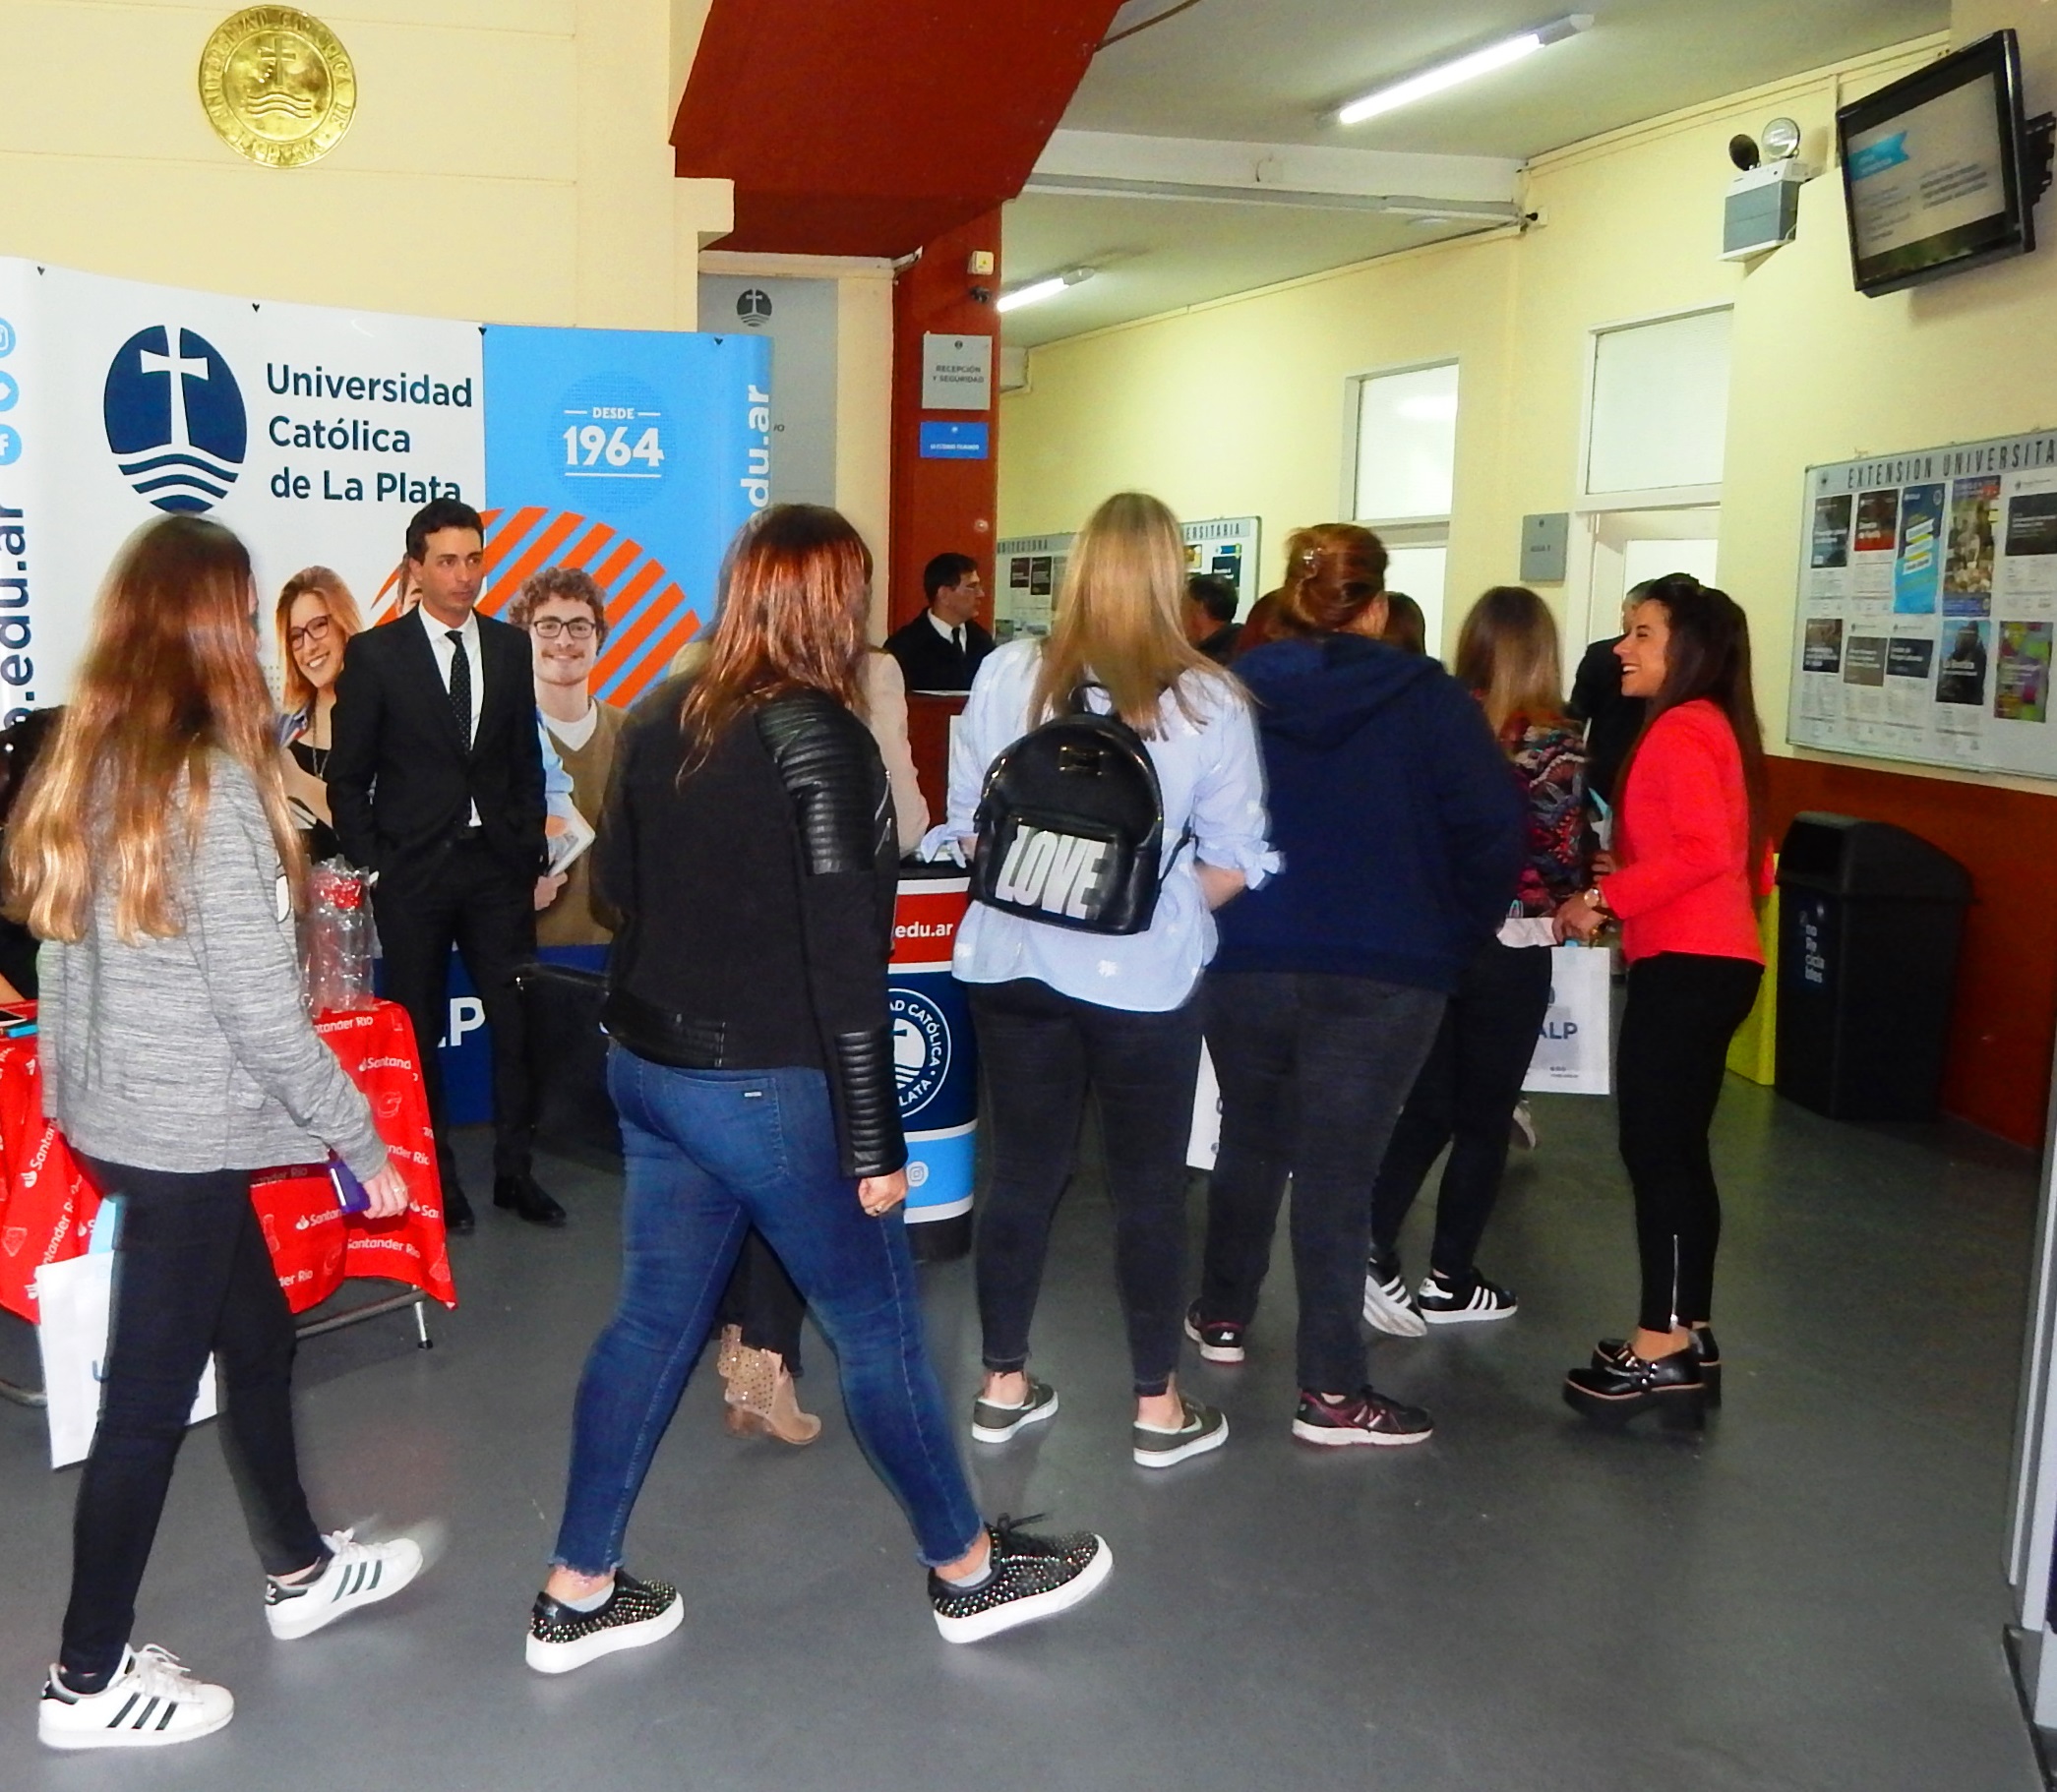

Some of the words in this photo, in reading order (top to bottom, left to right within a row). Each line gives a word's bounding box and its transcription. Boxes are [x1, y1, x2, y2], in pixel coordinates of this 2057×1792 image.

[267, 362, 472, 407] Universidad
[592, 407, 635, 419] DESDE
[269, 415, 410, 453] Católica
[563, 425, 665, 467] 1964
[271, 466, 311, 499] de
[324, 470, 363, 501] La
[377, 472, 461, 503] Plata
[1847, 456, 1932, 489] EXTENSION
[996, 824, 1108, 921] LOVE
[894, 921, 953, 938] edu.ar
[908, 1003, 941, 1067] CATÓLICA
